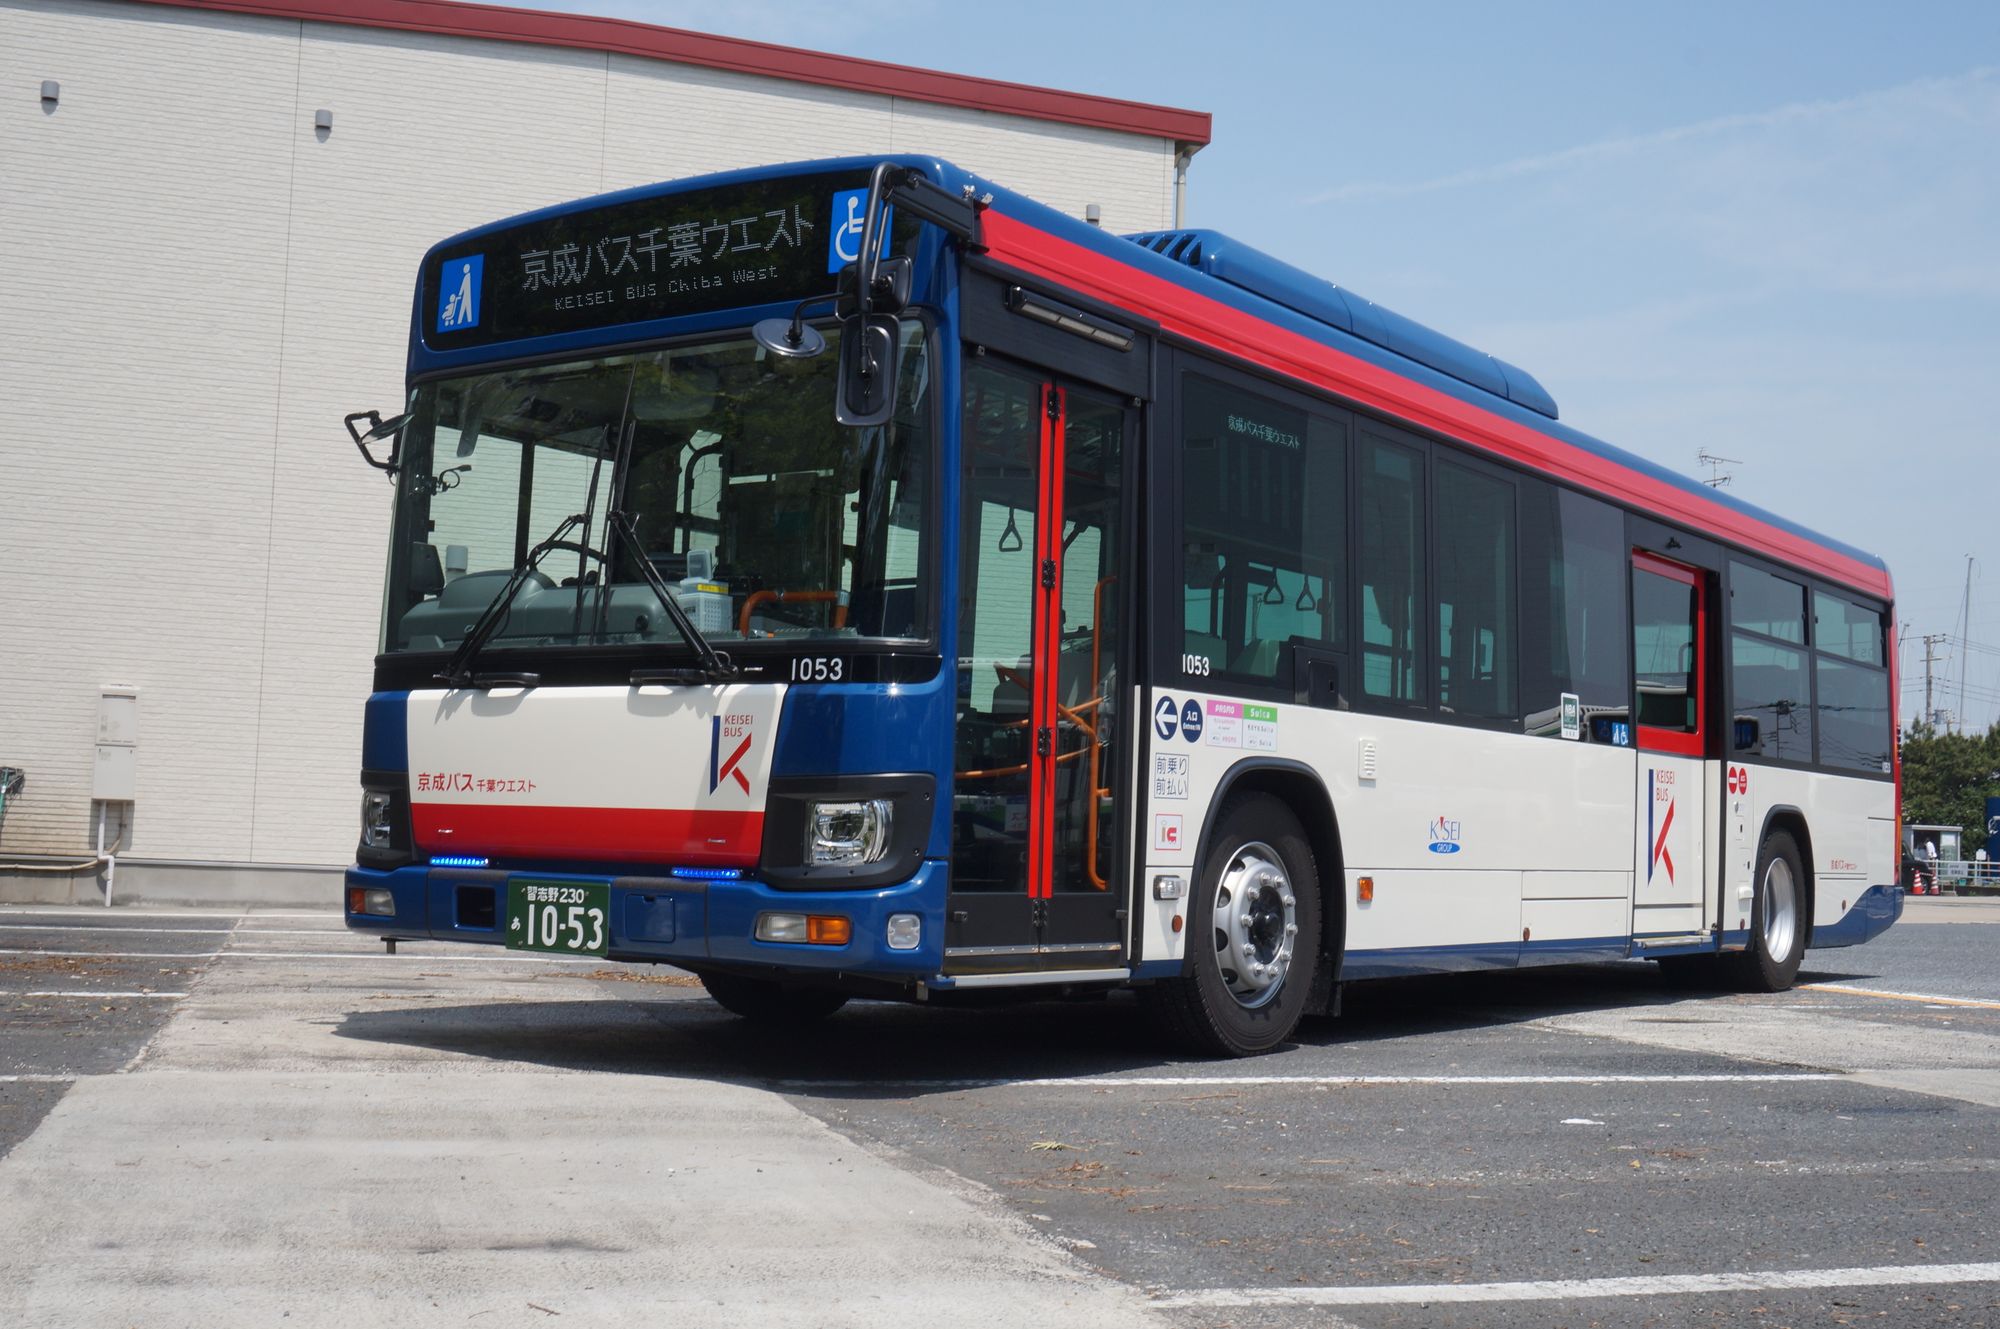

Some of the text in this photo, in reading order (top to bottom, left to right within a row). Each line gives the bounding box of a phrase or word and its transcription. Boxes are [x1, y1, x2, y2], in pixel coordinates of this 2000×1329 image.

[520, 204, 815, 291] 京成バス千葉ウエスト
[554, 265, 778, 311] KEISEI BUS Chiba West
[1227, 414, 1300, 449] 京成バス千葉ウエスト
[791, 658, 843, 681] 1053
[1182, 654, 1210, 676] 1053
[724, 714, 754, 725] KEISEI
[1186, 710, 1198, 722] 入口
[723, 727, 743, 737] BUS
[1156, 757, 1188, 776] 前乗り
[1656, 769, 1676, 785] KEISEI
[1156, 778, 1188, 796] 前払い
[1656, 787, 1669, 802] BUS
[510, 904, 604, 950] あ 10-53
